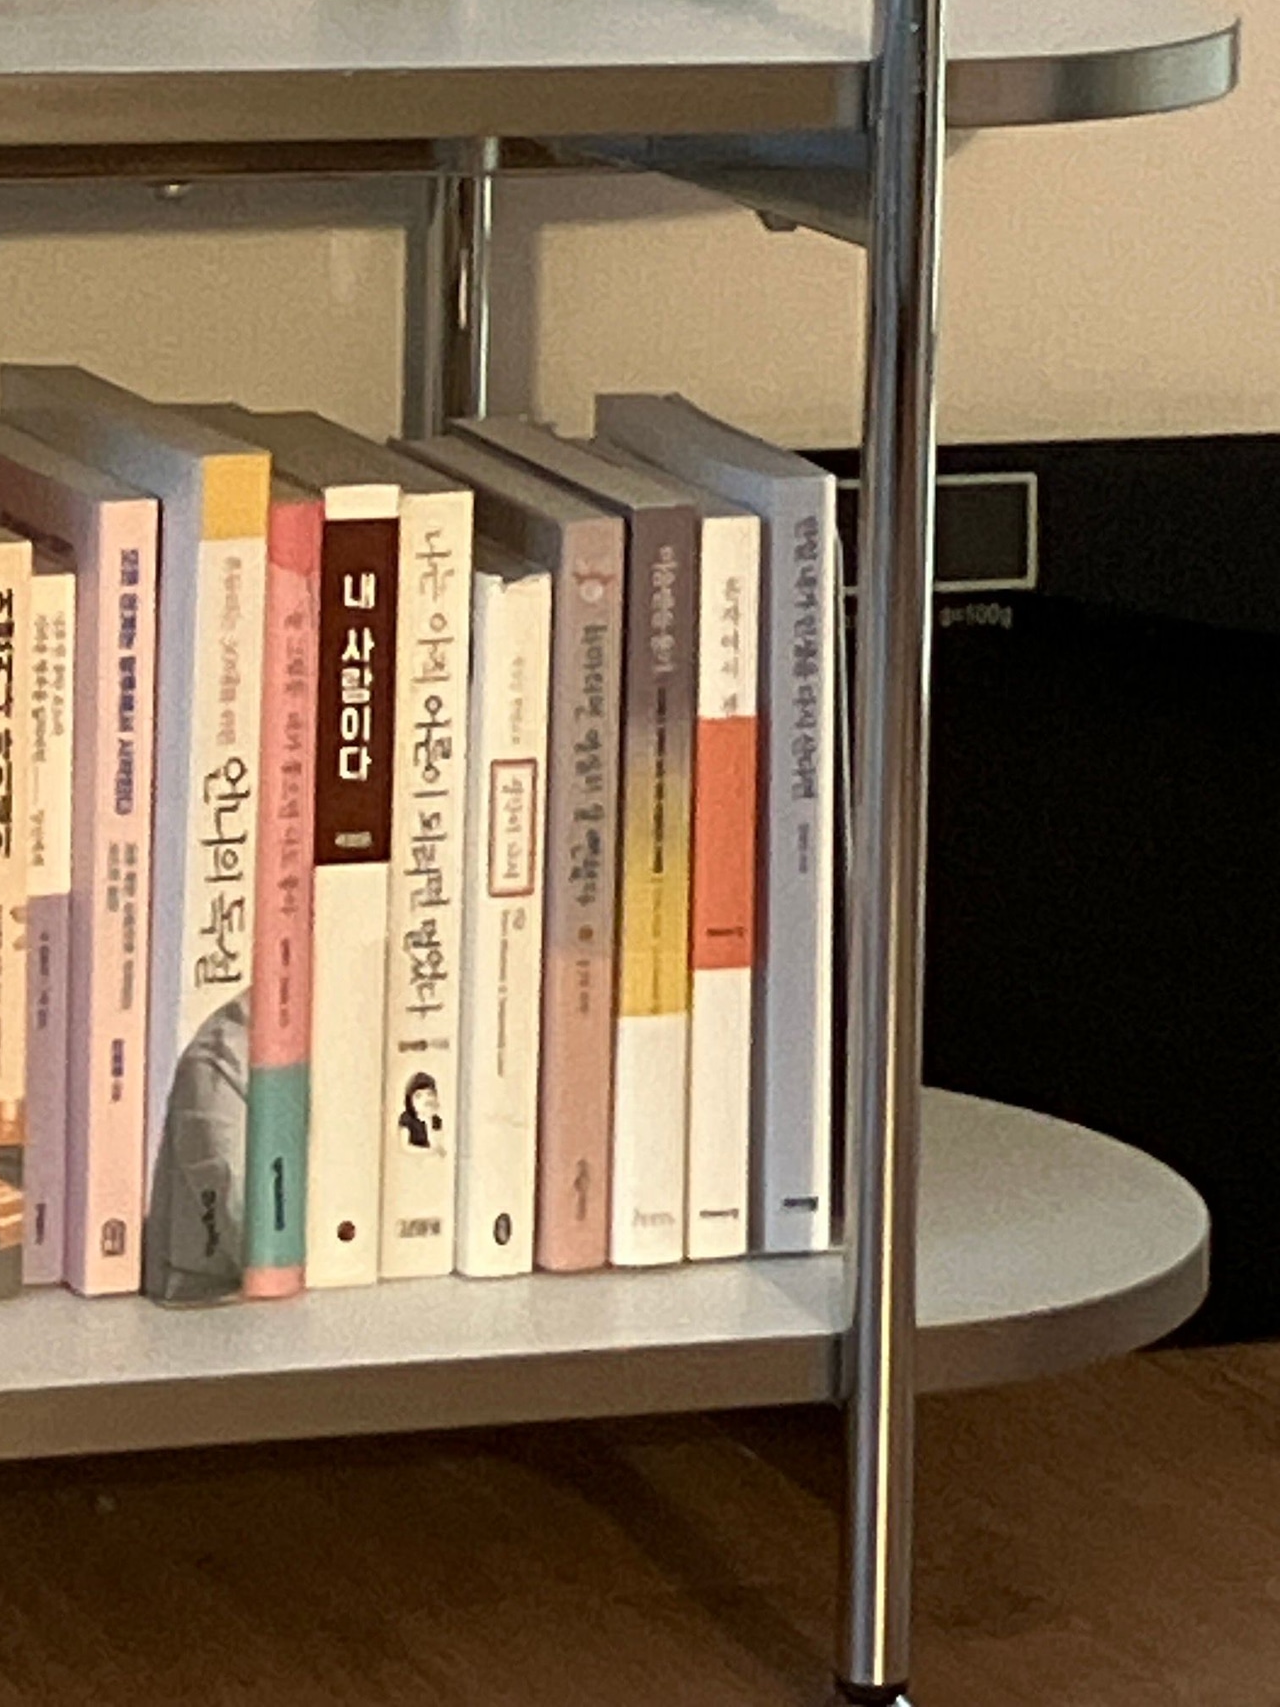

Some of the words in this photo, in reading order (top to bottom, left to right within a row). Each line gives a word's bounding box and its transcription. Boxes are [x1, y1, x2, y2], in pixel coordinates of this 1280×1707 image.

[343, 572, 377, 610] 내
[412, 526, 456, 603] 나는
[410, 612, 456, 686] 아직
[338, 626, 376, 782] 사람이다
[412, 695, 455, 798] 어른이
[200, 756, 253, 884] 언니의
[403, 811, 452, 912] 되려면
[195, 891, 247, 988] 독설
[402, 918, 450, 1019] 멀었다
